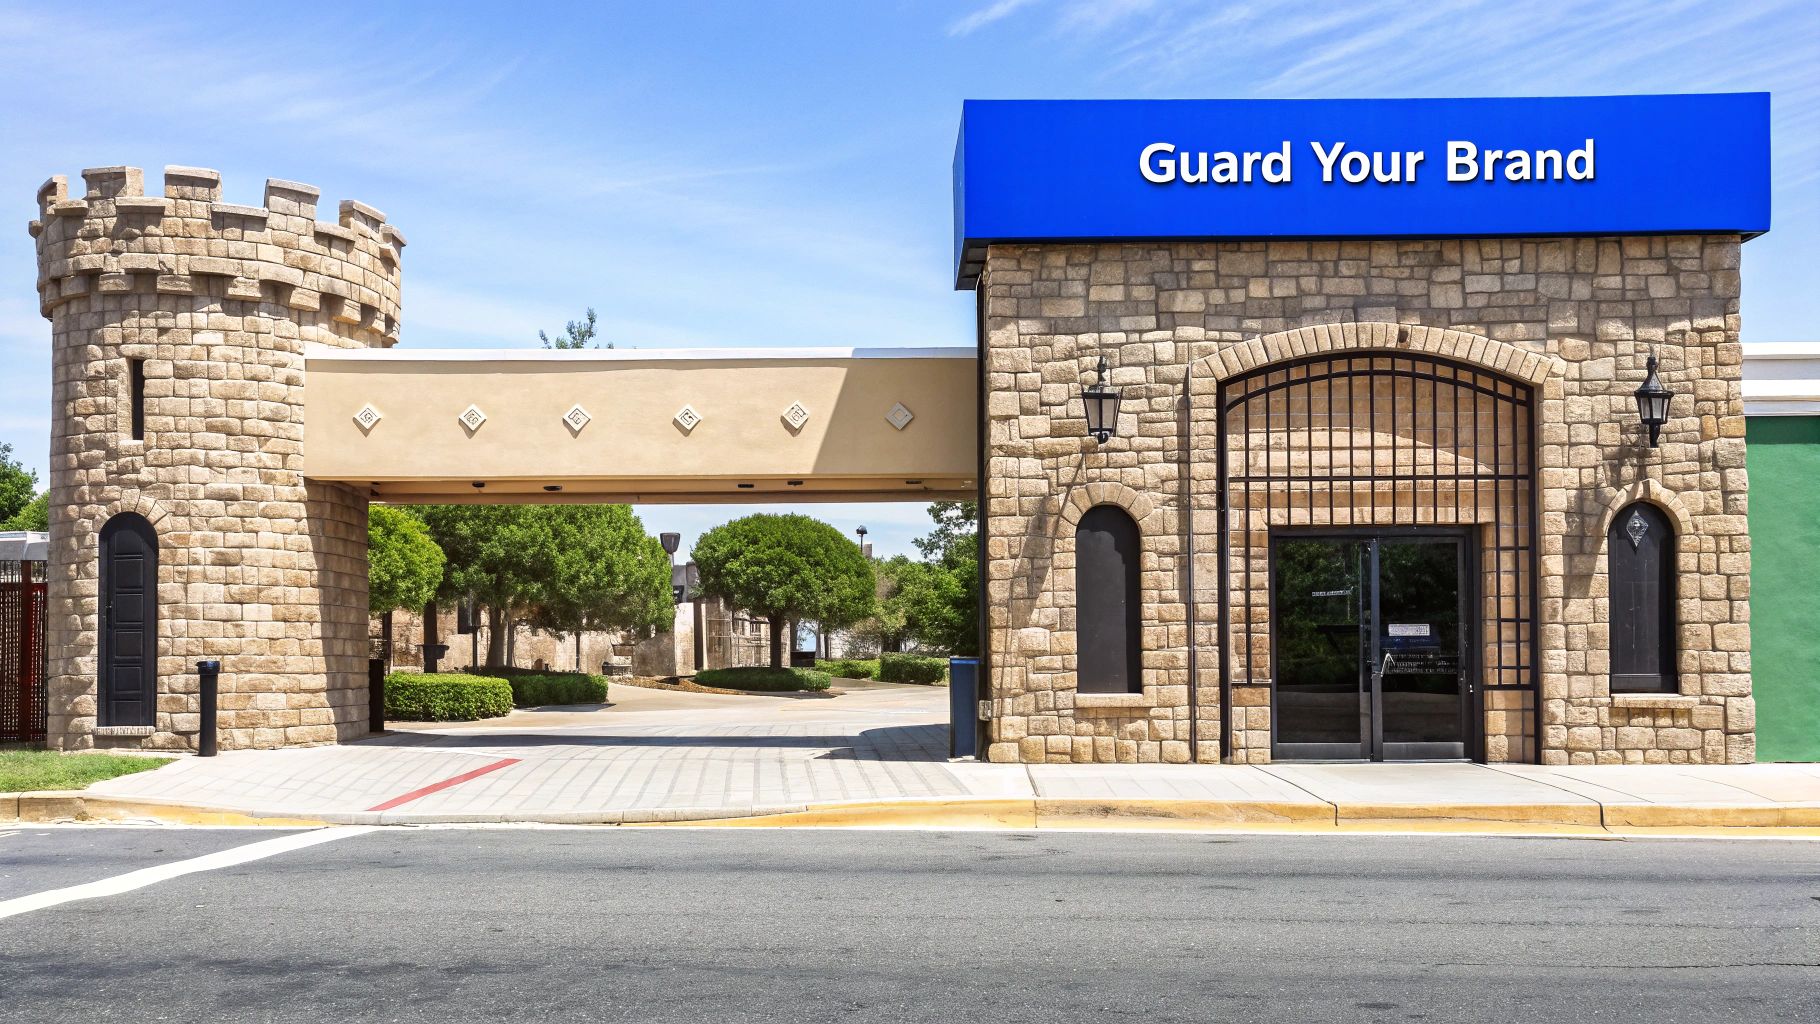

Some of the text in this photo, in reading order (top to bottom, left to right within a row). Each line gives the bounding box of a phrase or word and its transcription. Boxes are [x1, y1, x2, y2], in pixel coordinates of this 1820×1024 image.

[1139, 139, 1595, 184] Guard Your Brand
